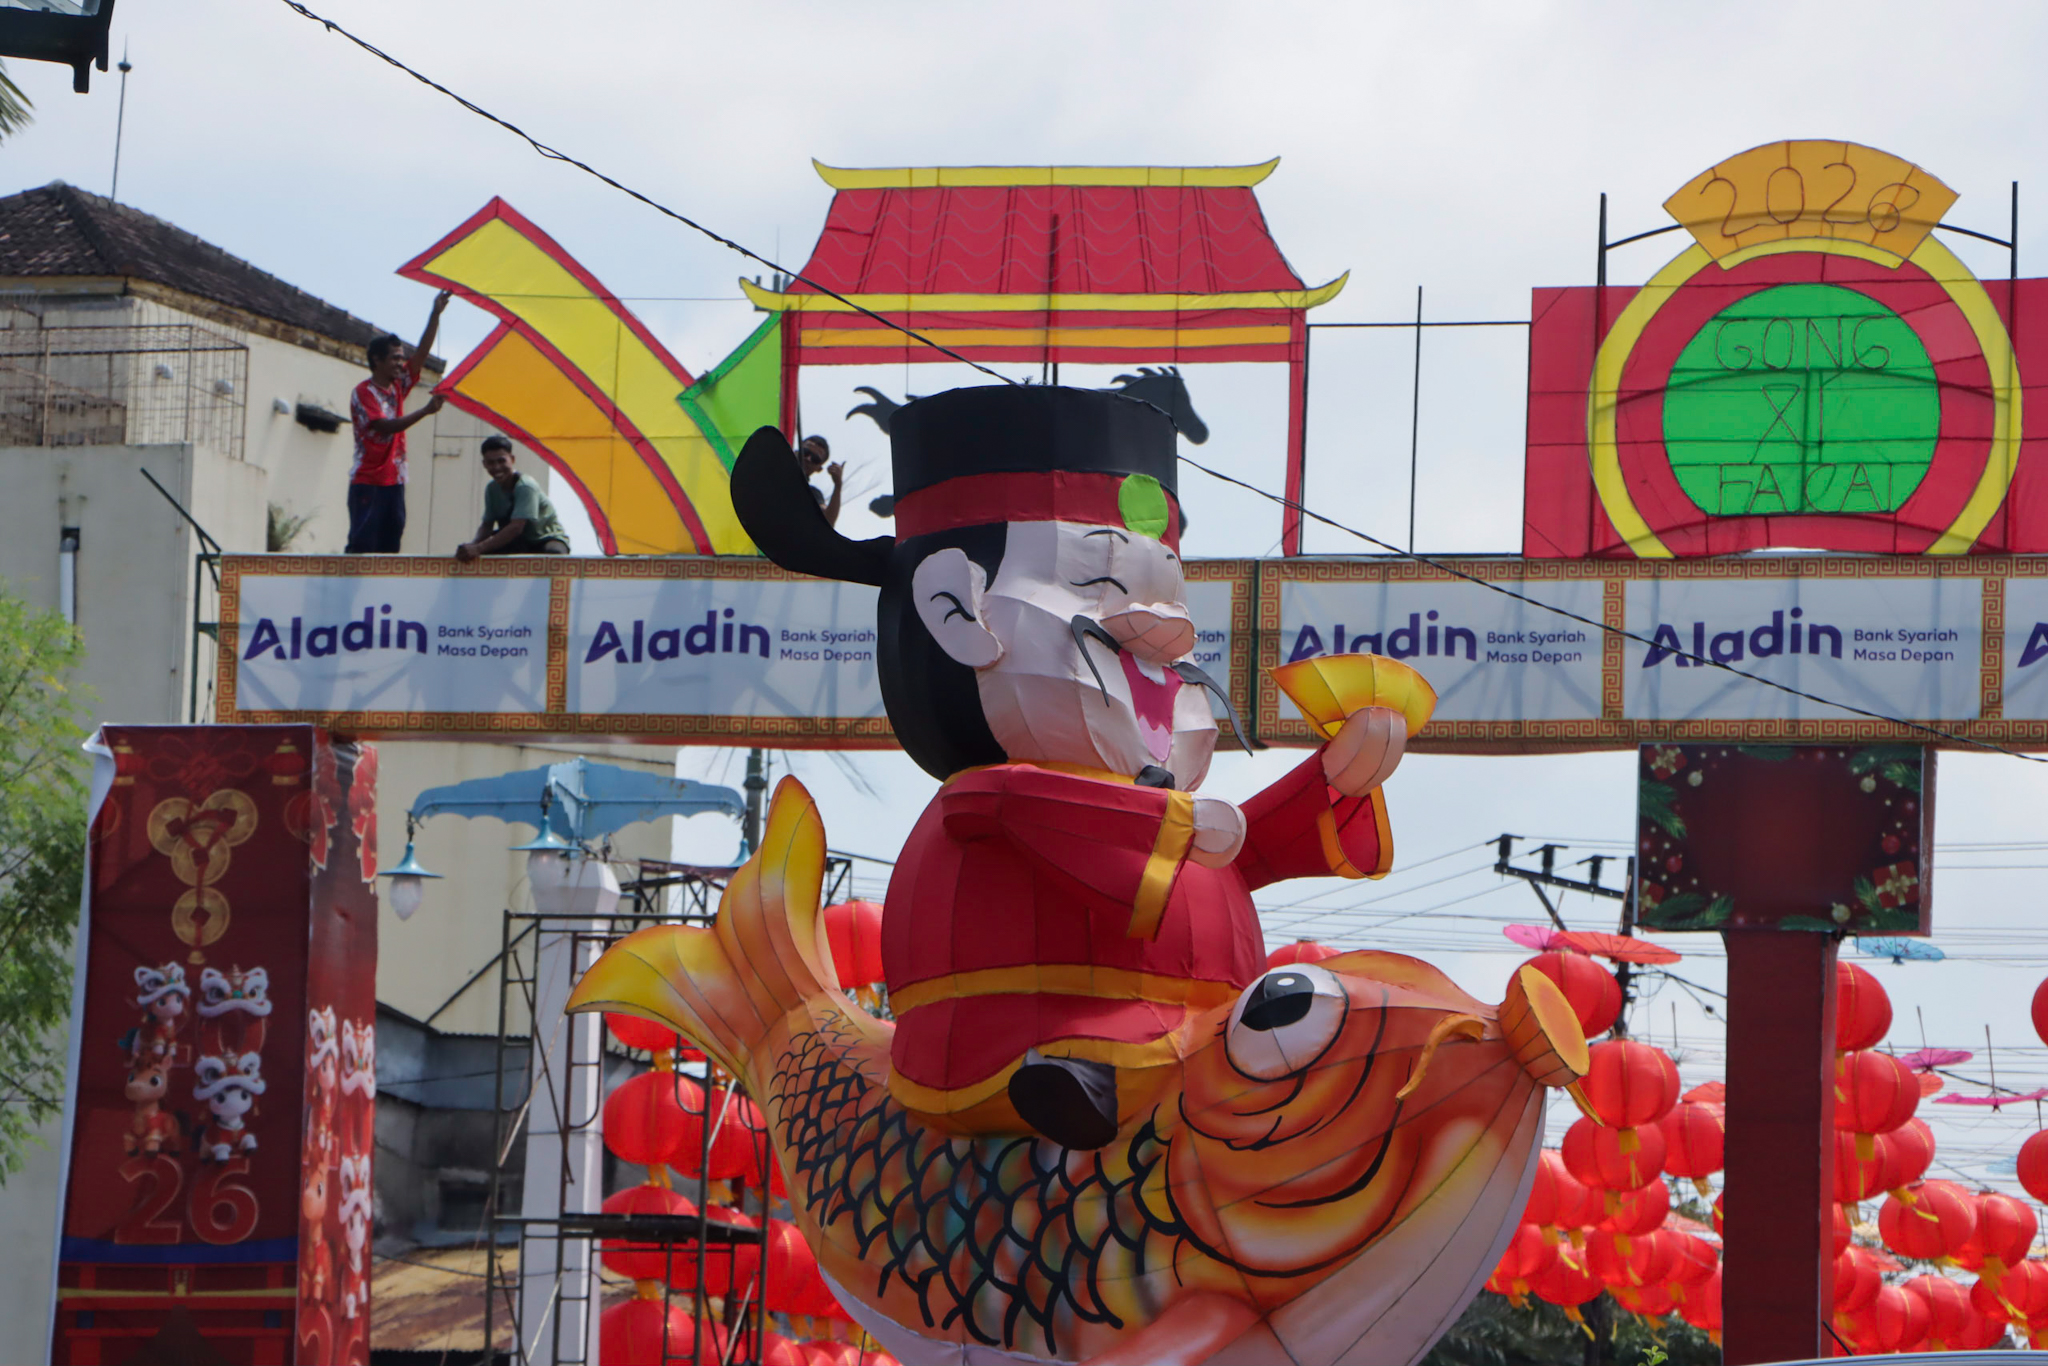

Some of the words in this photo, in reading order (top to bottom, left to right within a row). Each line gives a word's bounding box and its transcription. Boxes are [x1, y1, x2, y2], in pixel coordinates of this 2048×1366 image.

[1700, 162, 1920, 238] 2026
[1715, 315, 1890, 371] GONG
[1761, 383, 1824, 446] XI
[1718, 463, 1893, 514] FACAI
[243, 603, 428, 661] Aladin
[438, 625, 474, 638] Bank
[478, 625, 532, 641] Syariah
[584, 607, 771, 664] Aladin
[781, 629, 817, 642] Bank
[821, 629, 876, 645] Syariah
[1197, 630, 1225, 643] riah
[1287, 609, 1477, 664] Aladin
[1487, 631, 1524, 644] Bank
[1529, 630, 1586, 646] Syariah
[1642, 606, 1842, 669] Aladin
[1854, 628, 1894, 642] Bank
[1898, 628, 1958, 645] Syariah
[437, 644, 476, 657] Masa
[480, 644, 529, 660] Depan
[780, 648, 819, 661] Masa
[823, 648, 872, 664] Depan
[1193, 652, 1221, 662] pan
[1486, 650, 1528, 663] Masa
[1532, 650, 1582, 666] Depan
[1853, 648, 1897, 661] Masa
[1901, 648, 1954, 664] Depan
[114, 1154, 259, 1245] 26
